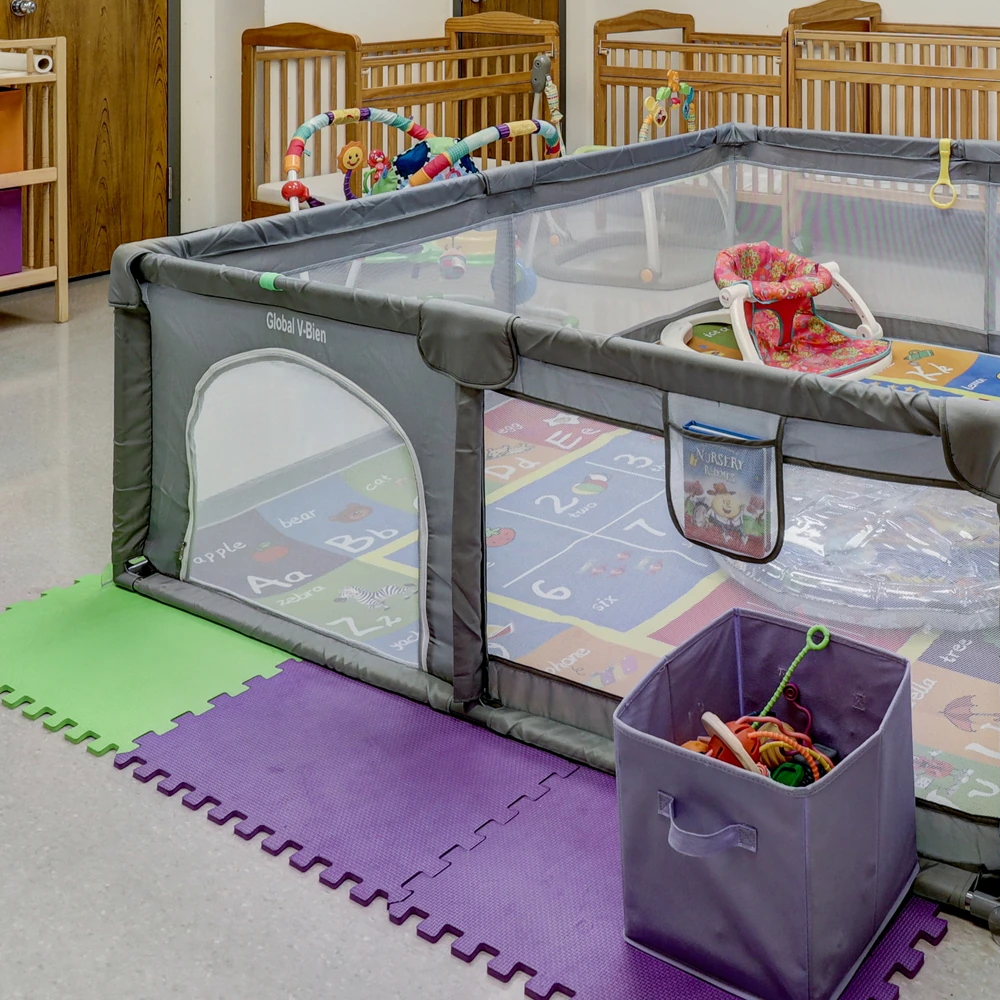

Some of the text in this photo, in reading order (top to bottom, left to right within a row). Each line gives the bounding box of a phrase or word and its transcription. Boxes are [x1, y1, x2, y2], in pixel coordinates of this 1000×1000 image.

[266, 311, 327, 344] Global V-Bien
[696, 447, 744, 471] NURSERY
[535, 494, 579, 514] 2
[569, 502, 598, 518] two
[280, 508, 317, 529] bear
[623, 518, 666, 536] 7
[324, 526, 399, 553] Bb
[192, 540, 247, 564] apple
[246, 569, 313, 595] Aa
[531, 579, 571, 600] 6
[276, 584, 327, 606] zebra
[592, 595, 618, 612] six
[326, 614, 402, 637] Zz
[939, 638, 973, 663] tree
